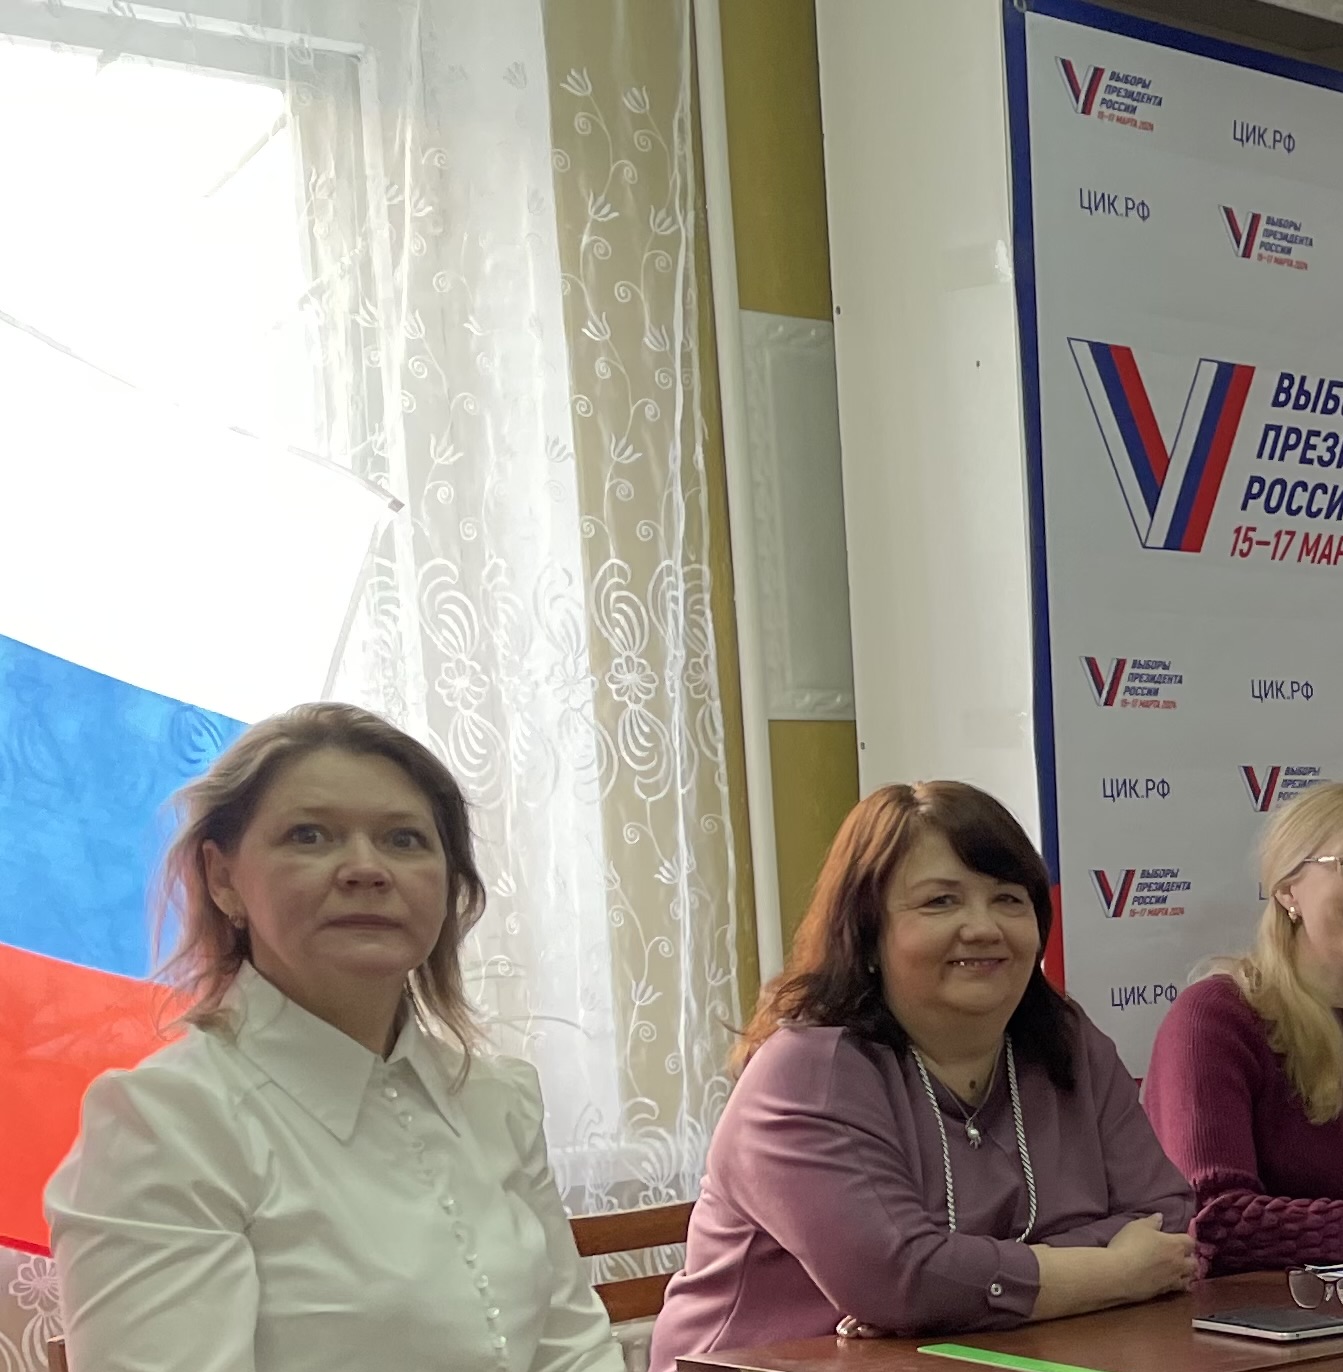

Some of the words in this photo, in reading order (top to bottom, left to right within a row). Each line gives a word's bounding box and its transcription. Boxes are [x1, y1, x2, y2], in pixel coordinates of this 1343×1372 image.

[1109, 70, 1152, 89] ВЫБОРЫ
[1104, 84, 1162, 107] ПРЕЗИДЕНТА
[1100, 97, 1138, 115] РОССИИ
[1232, 119, 1296, 154] ЦИК.РФ
[1079, 187, 1150, 222] ЦИК.РФ
[1266, 215, 1302, 232] ВЫБОРЫ
[1262, 228, 1314, 247] ПРЕЗИДЕНТА
[1259, 240, 1292, 256] РОССИИ
[1131, 659, 1171, 670] ВЫБОРЫ
[1127, 672, 1183, 685] ПРЕЗИДЕНТА
[1123, 685, 1159, 696] РОССИИ
[1251, 679, 1314, 704] ЦИК.РФ
[1102, 777, 1171, 803] ЦИК.РФ
[1140, 868, 1180, 879] ВЫБОРЫ
[1136, 881, 1191, 892] ПРЕЗИДЕНТА
[1132, 895, 1168, 905] РОССИИ
[1110, 982, 1178, 1011] ЦИК.РФ
